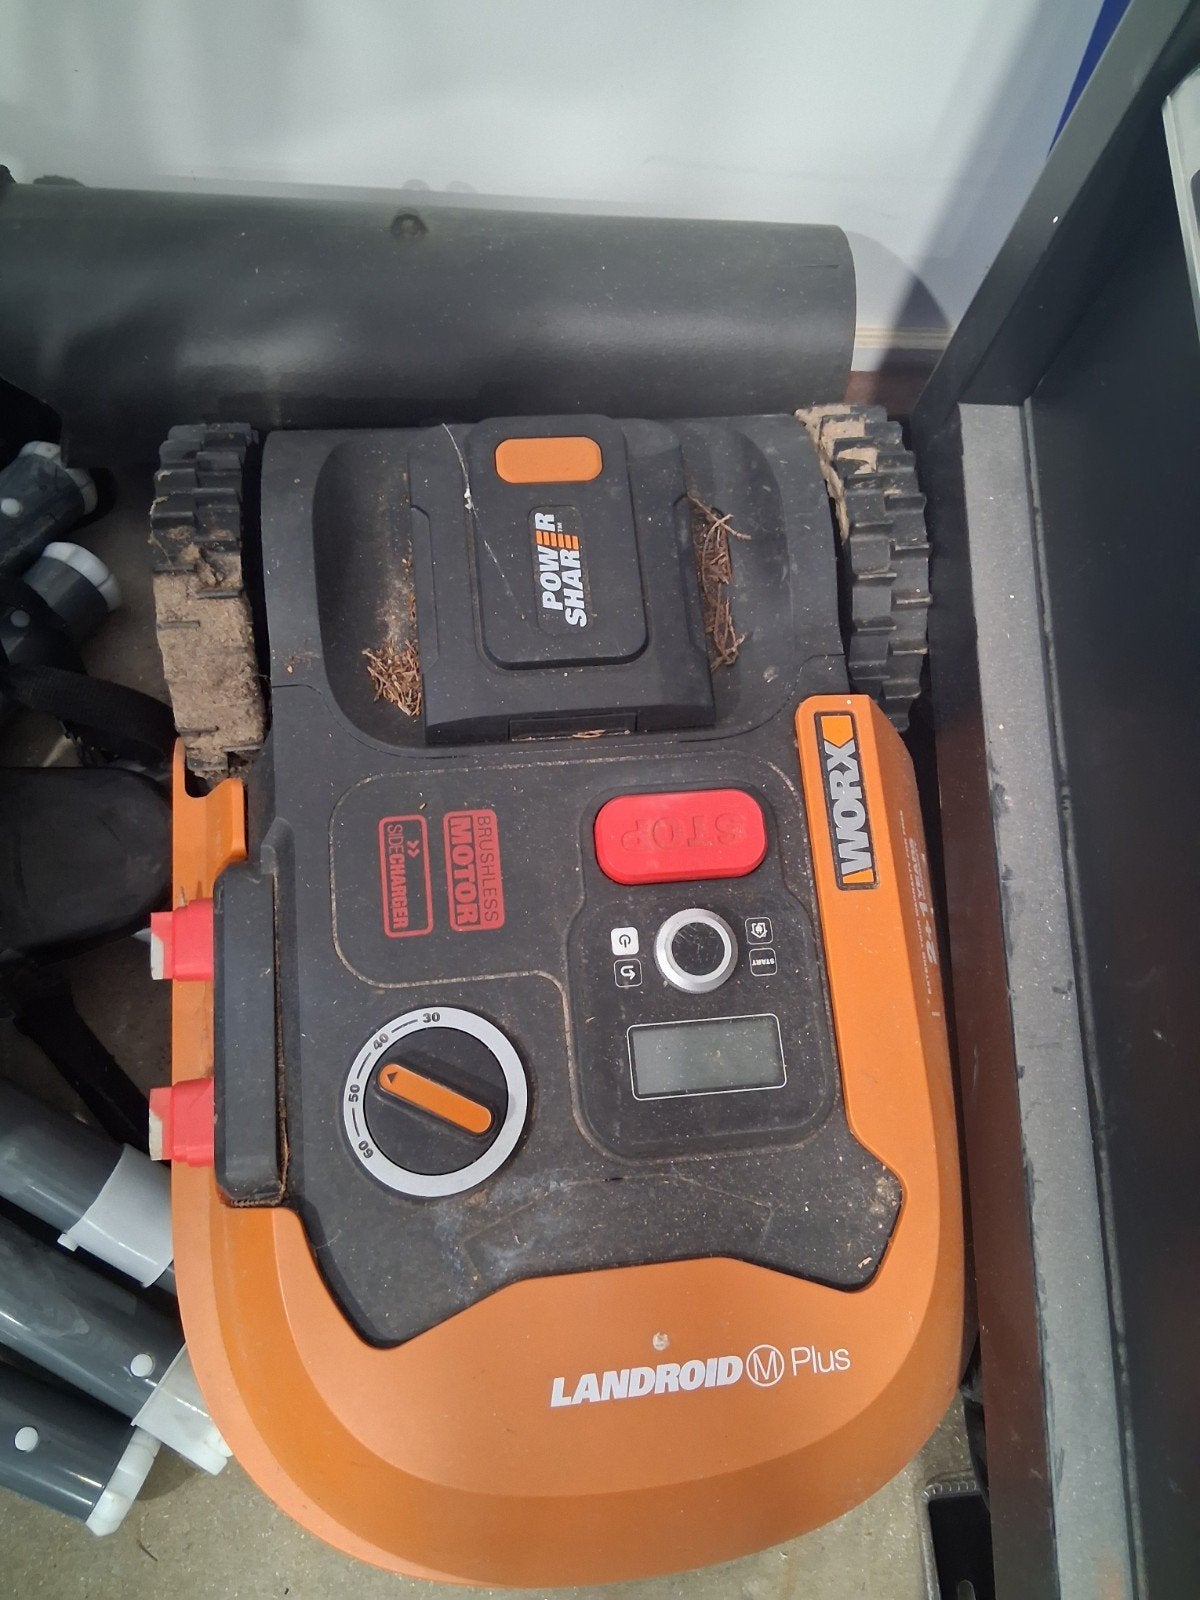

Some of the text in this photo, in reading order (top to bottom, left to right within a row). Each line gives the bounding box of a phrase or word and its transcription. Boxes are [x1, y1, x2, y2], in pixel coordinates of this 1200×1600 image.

[824, 739, 873, 875] WORX
[621, 812, 741, 851] STOP
[387, 824, 409, 930] SIDECHARGER
[449, 816, 480, 927] MOTOR
[477, 815, 499, 923] BRUSHLESS
[752, 958, 775, 966] START
[423, 1012, 441, 1023] 30
[373, 1033, 389, 1050] 40
[348, 1084, 361, 1103] 50
[358, 1140, 374, 1159] 60
[550, 1345, 851, 1408] LANDROID M Plus
